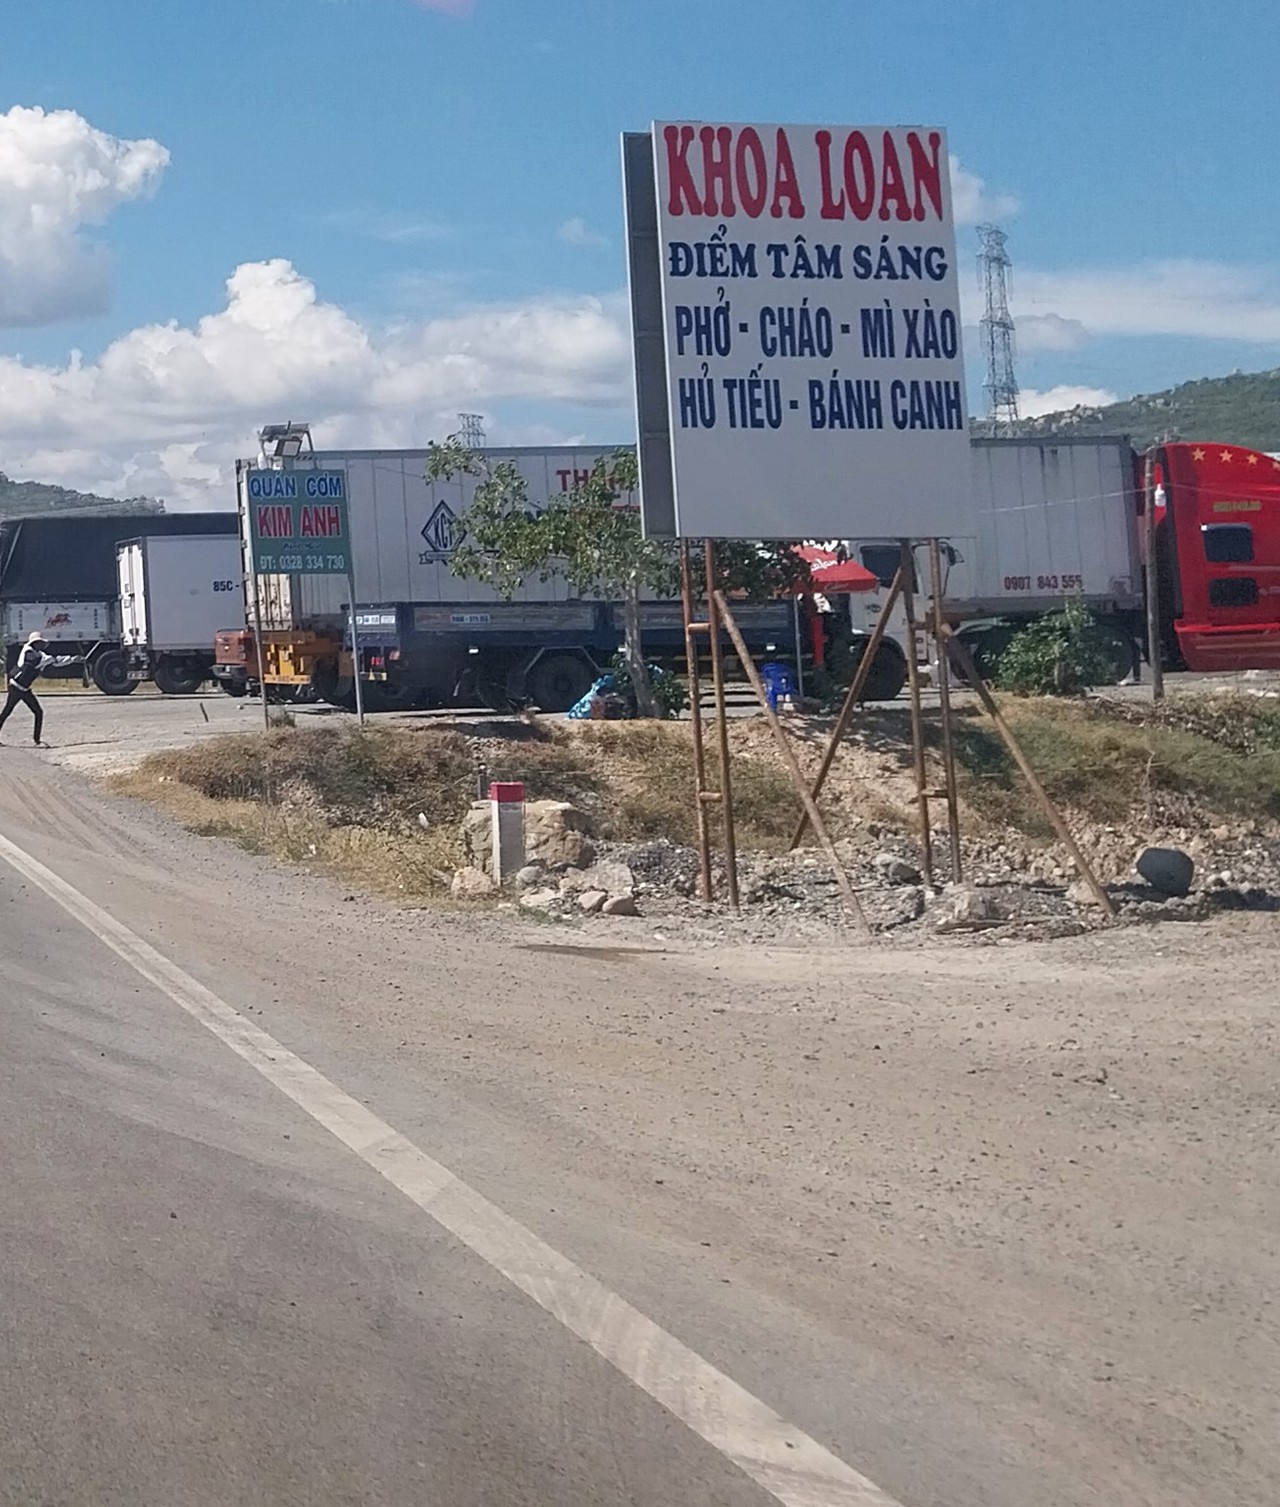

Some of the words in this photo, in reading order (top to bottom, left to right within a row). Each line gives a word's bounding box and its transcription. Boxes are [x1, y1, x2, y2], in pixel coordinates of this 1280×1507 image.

[663, 126, 805, 218] KHOA
[815, 130, 943, 221] LOAN
[668, 224, 758, 278] ĐIỂM
[766, 235, 843, 280] TÂM
[853, 235, 949, 281] SÁNG
[675, 286, 731, 357] PHỞ
[759, 297, 833, 358] CHÁO
[860, 298, 896, 359] MÌ
[903, 298, 958, 359] XÀO
[679, 362, 716, 429] HỦ
[723, 363, 782, 429] TIẾU
[808, 369, 883, 429] BÁNH
[891, 380, 963, 430] CANH
[250, 472, 297, 497] QUÁN
[306, 472, 342, 497] CƠM
[257, 505, 293, 537] KIM
[301, 505, 341, 537] ANH
[260, 556, 276, 570] ĐT:
[280, 555, 302, 569] 0328
[307, 555, 324, 569] 334
[327, 555, 344, 569] 730
